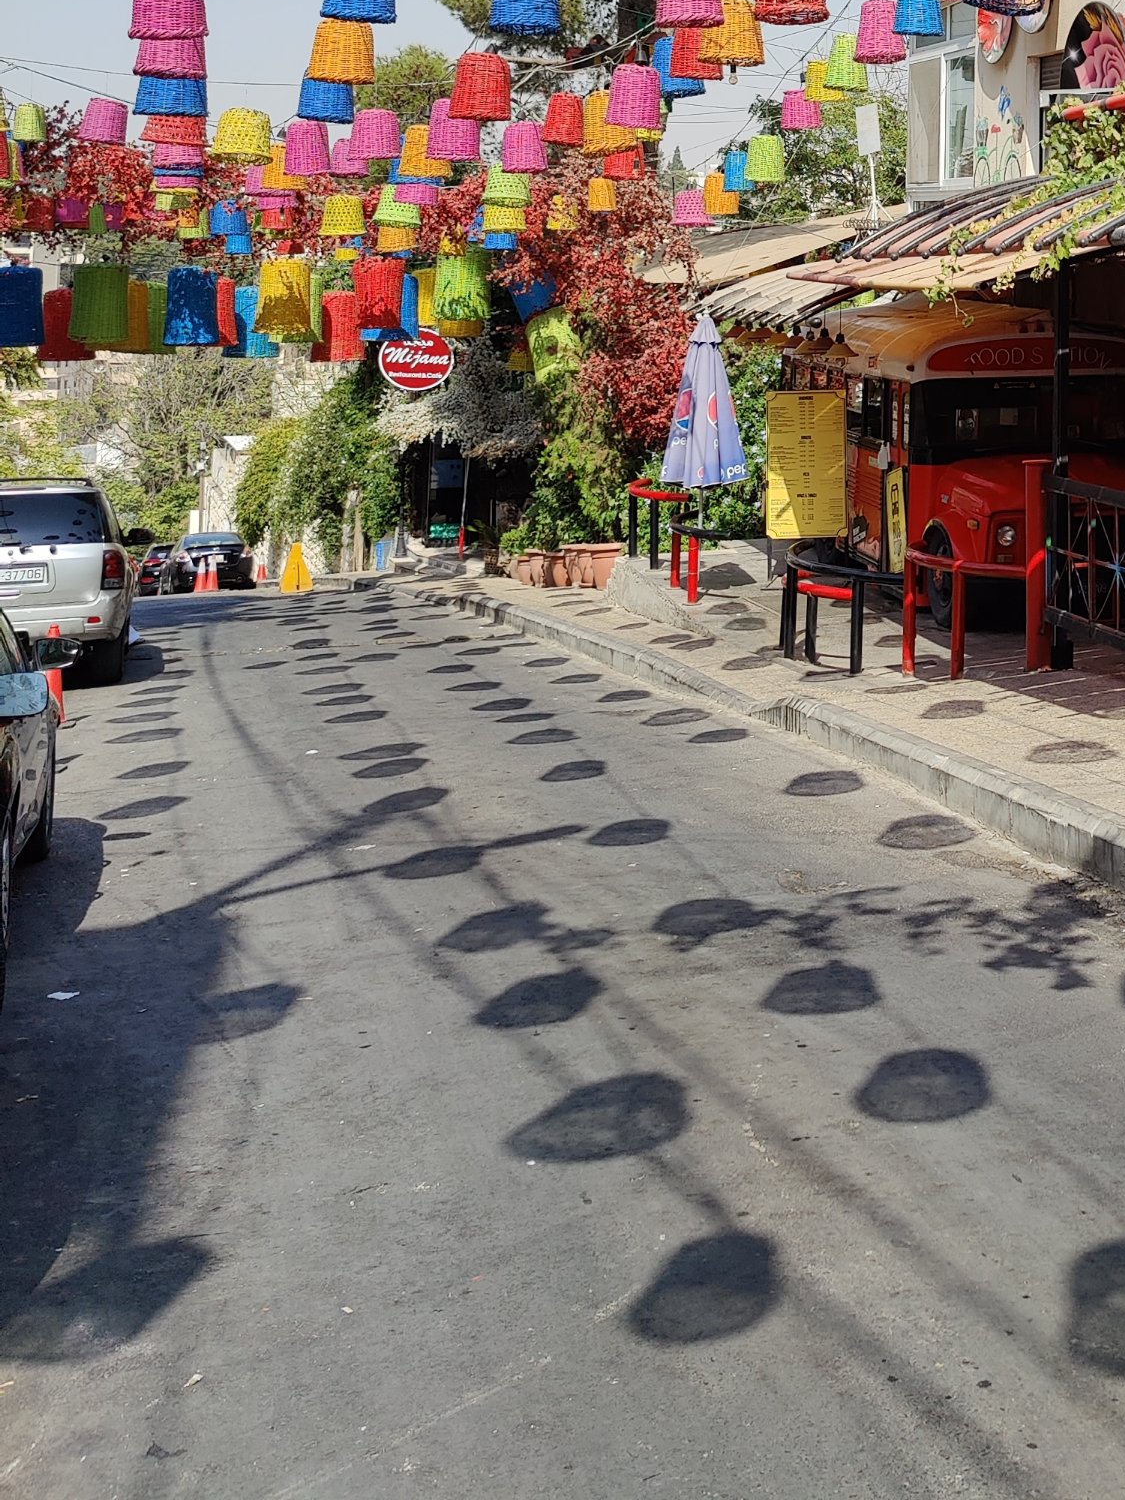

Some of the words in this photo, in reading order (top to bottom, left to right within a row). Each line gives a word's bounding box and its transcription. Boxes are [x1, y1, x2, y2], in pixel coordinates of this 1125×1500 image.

[384, 346, 450, 369] Mijana
[964, 348, 1025, 365] FOOD
[1030, 346, 1112, 369] STION
